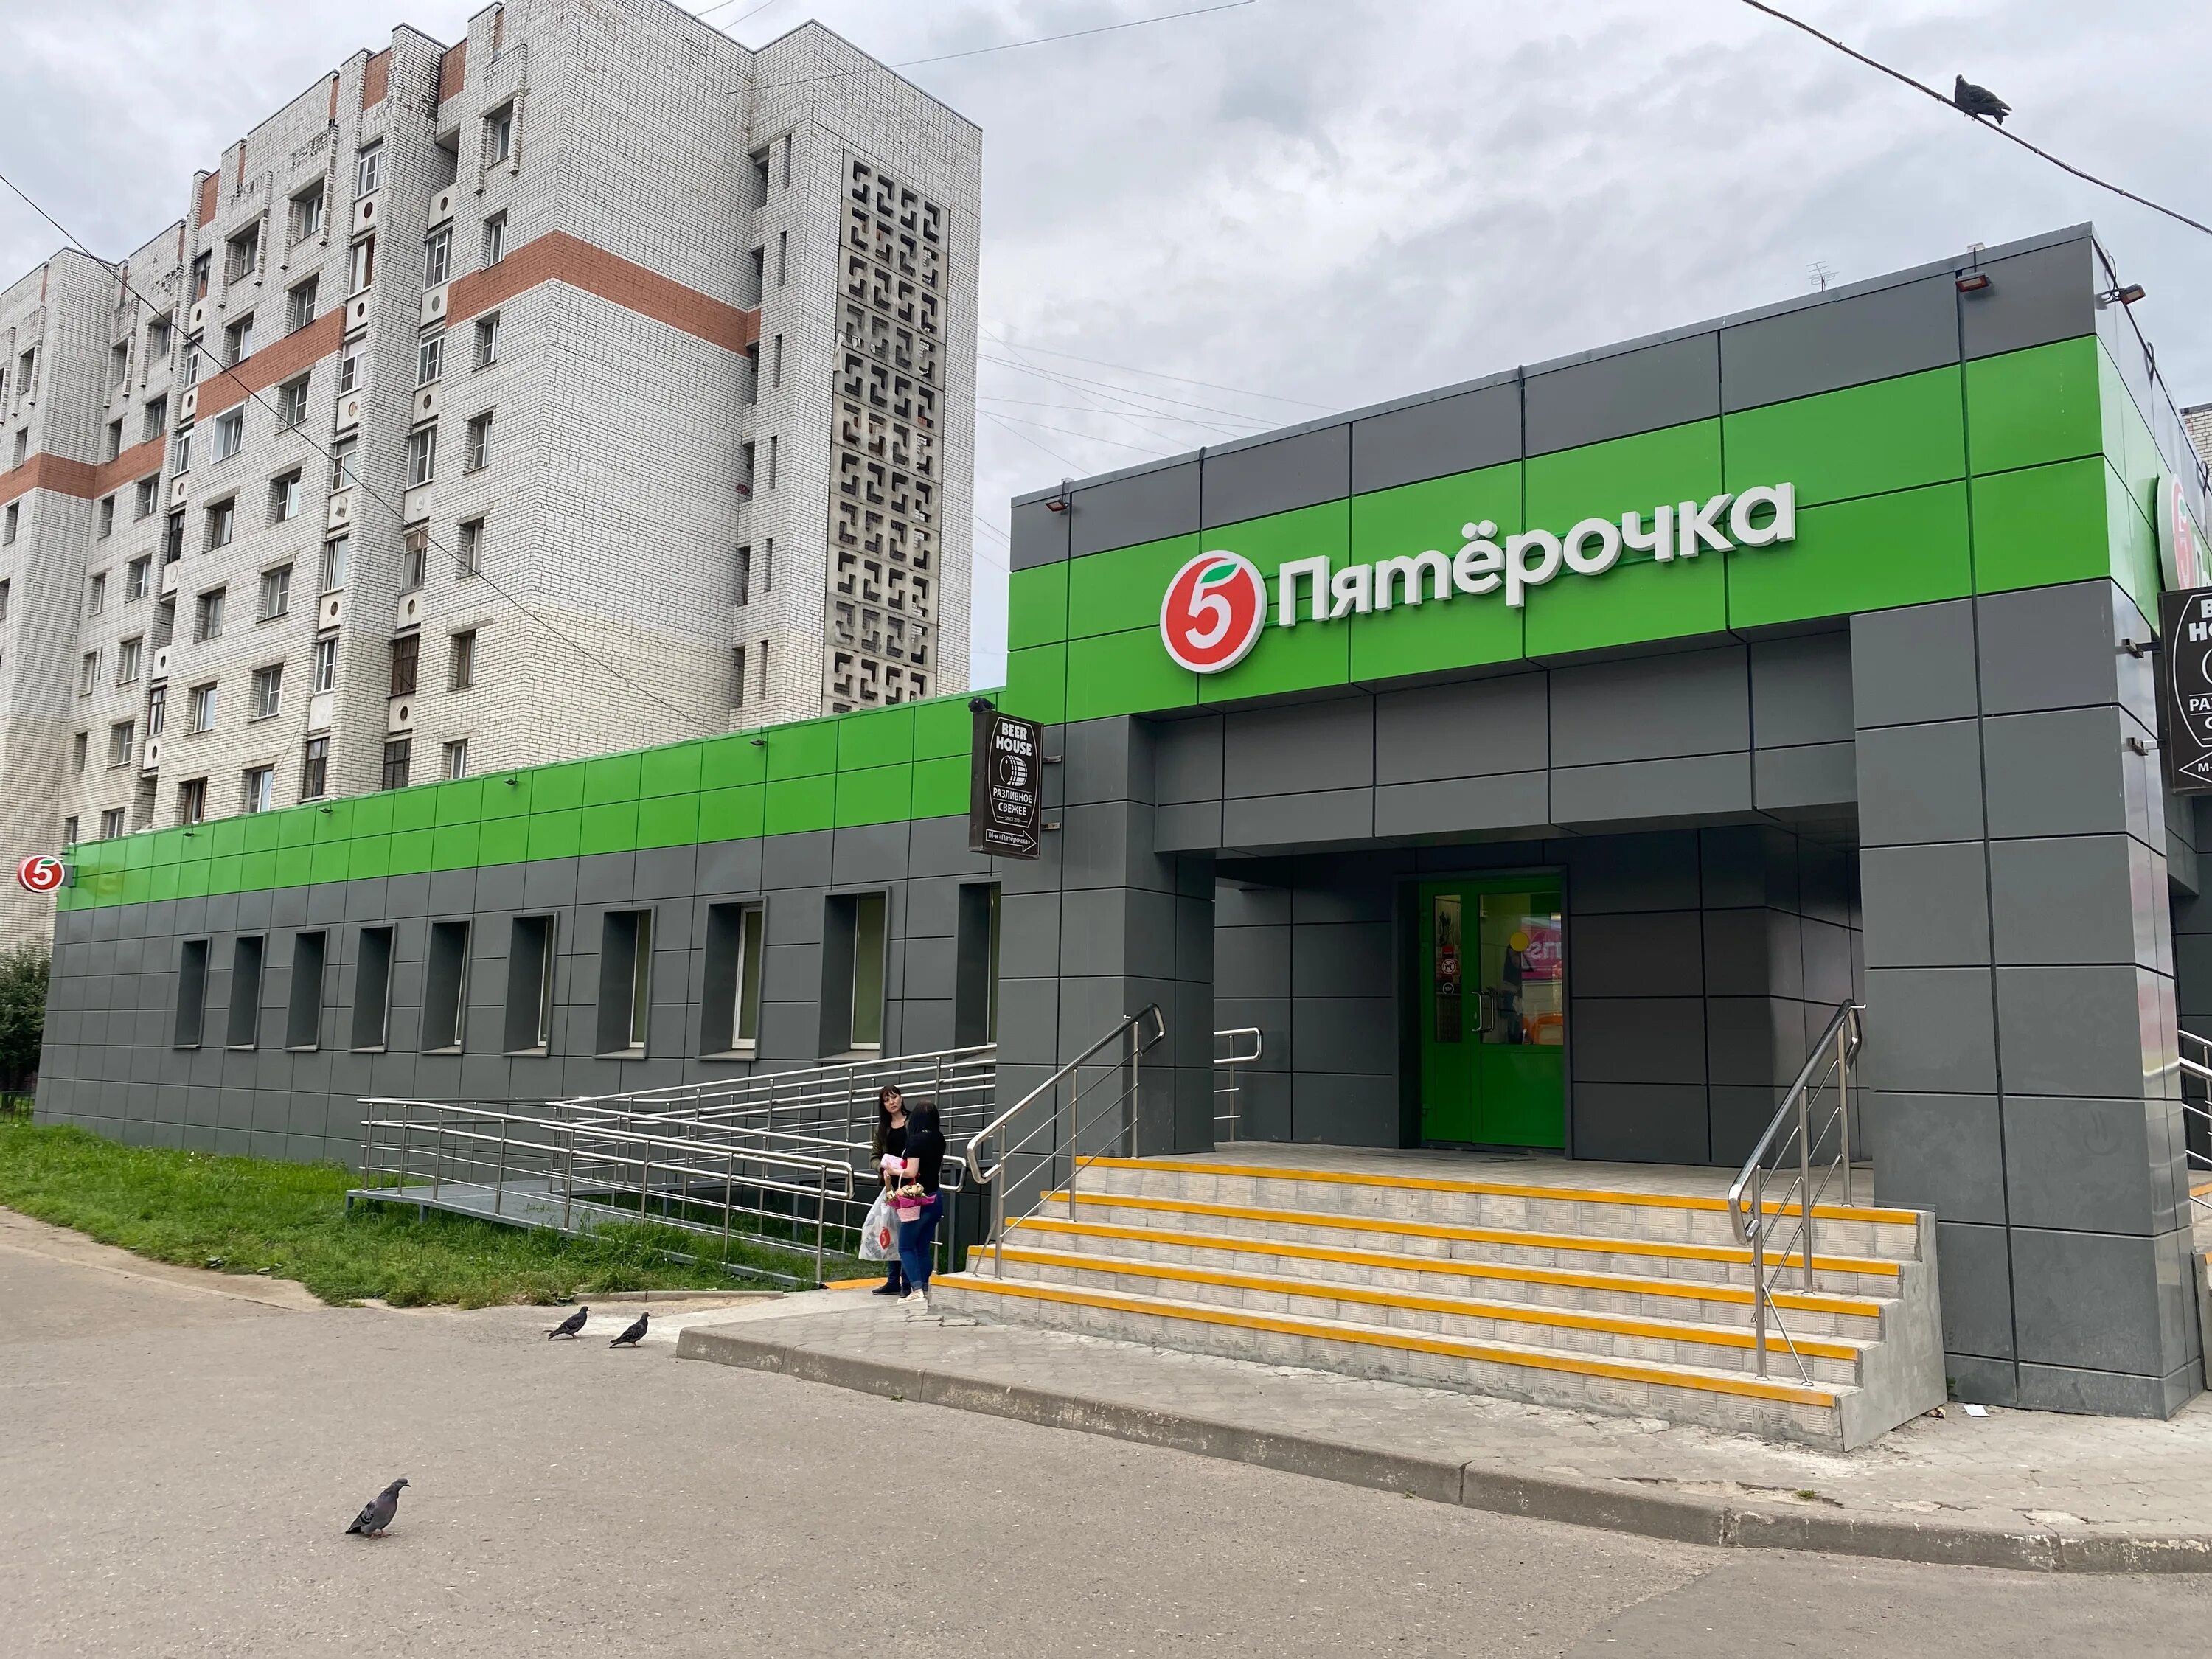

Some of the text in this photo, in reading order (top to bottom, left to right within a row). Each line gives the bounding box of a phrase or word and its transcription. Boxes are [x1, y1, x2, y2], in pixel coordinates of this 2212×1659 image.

[1279, 481, 1797, 627] Пятёрочка
[1001, 722, 1027, 740] BEER
[996, 736, 1032, 757] HOUSE
[993, 787, 1032, 804] РАЗЛИВНОЕ
[998, 801, 1027, 816] СВЕЖЕЕ
[988, 831, 1031, 845] М-н «Пятёрочка»
